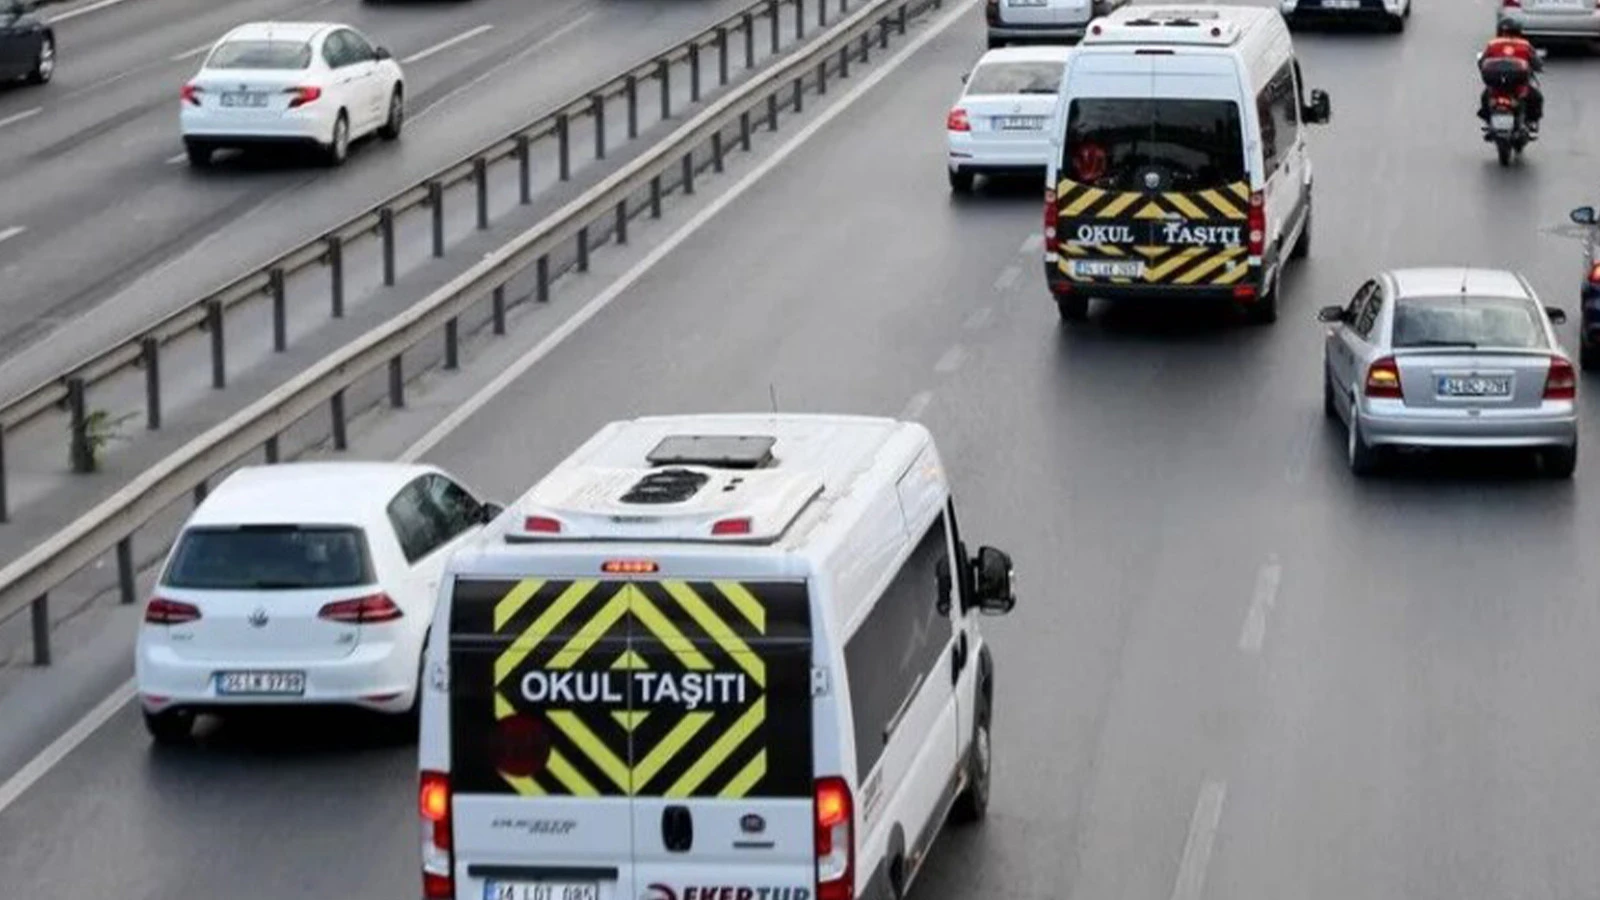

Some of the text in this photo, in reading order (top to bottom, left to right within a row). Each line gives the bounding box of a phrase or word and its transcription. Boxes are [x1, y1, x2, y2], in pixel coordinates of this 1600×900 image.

[1077, 225, 1134, 243] OKUL
[521, 671, 745, 709] OKUL TAŞITI
